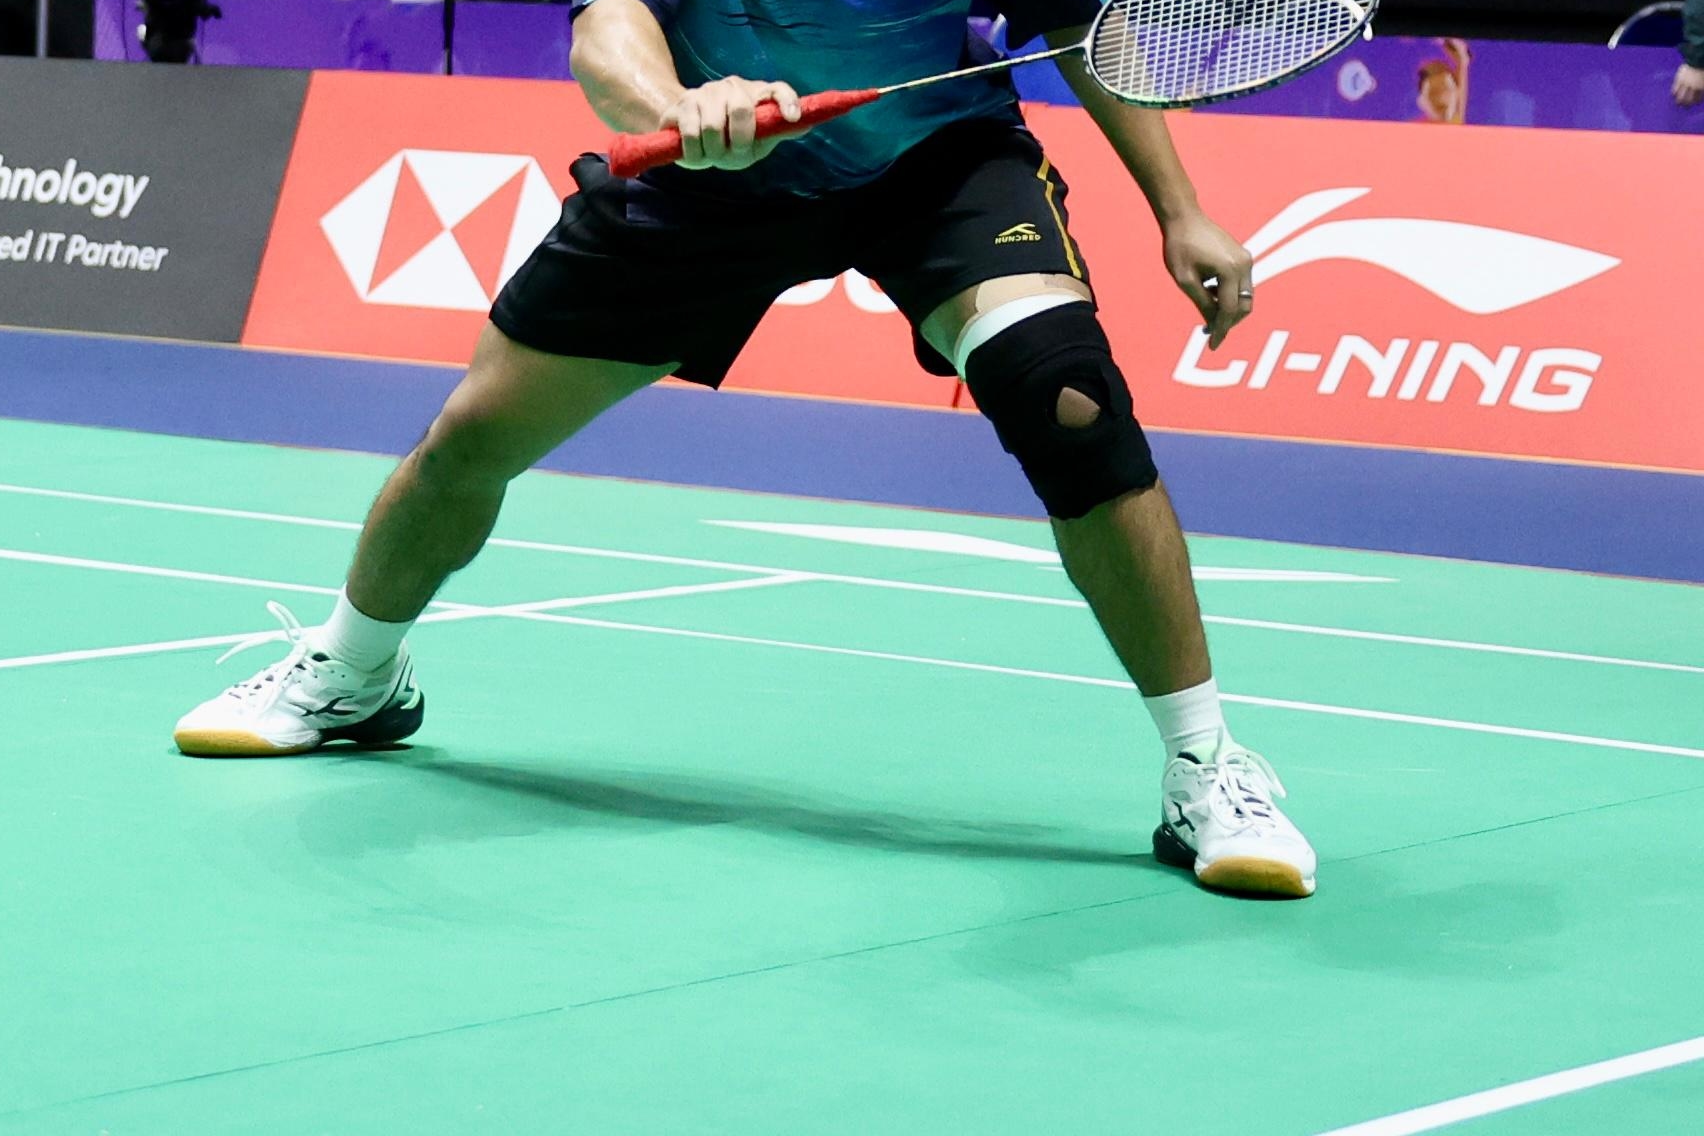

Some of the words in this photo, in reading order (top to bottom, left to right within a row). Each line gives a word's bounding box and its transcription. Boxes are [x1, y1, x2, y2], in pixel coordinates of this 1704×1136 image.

[32, 232, 66, 263] IT
[63, 234, 170, 272] Partner
[1172, 324, 1602, 413] LI-NING
